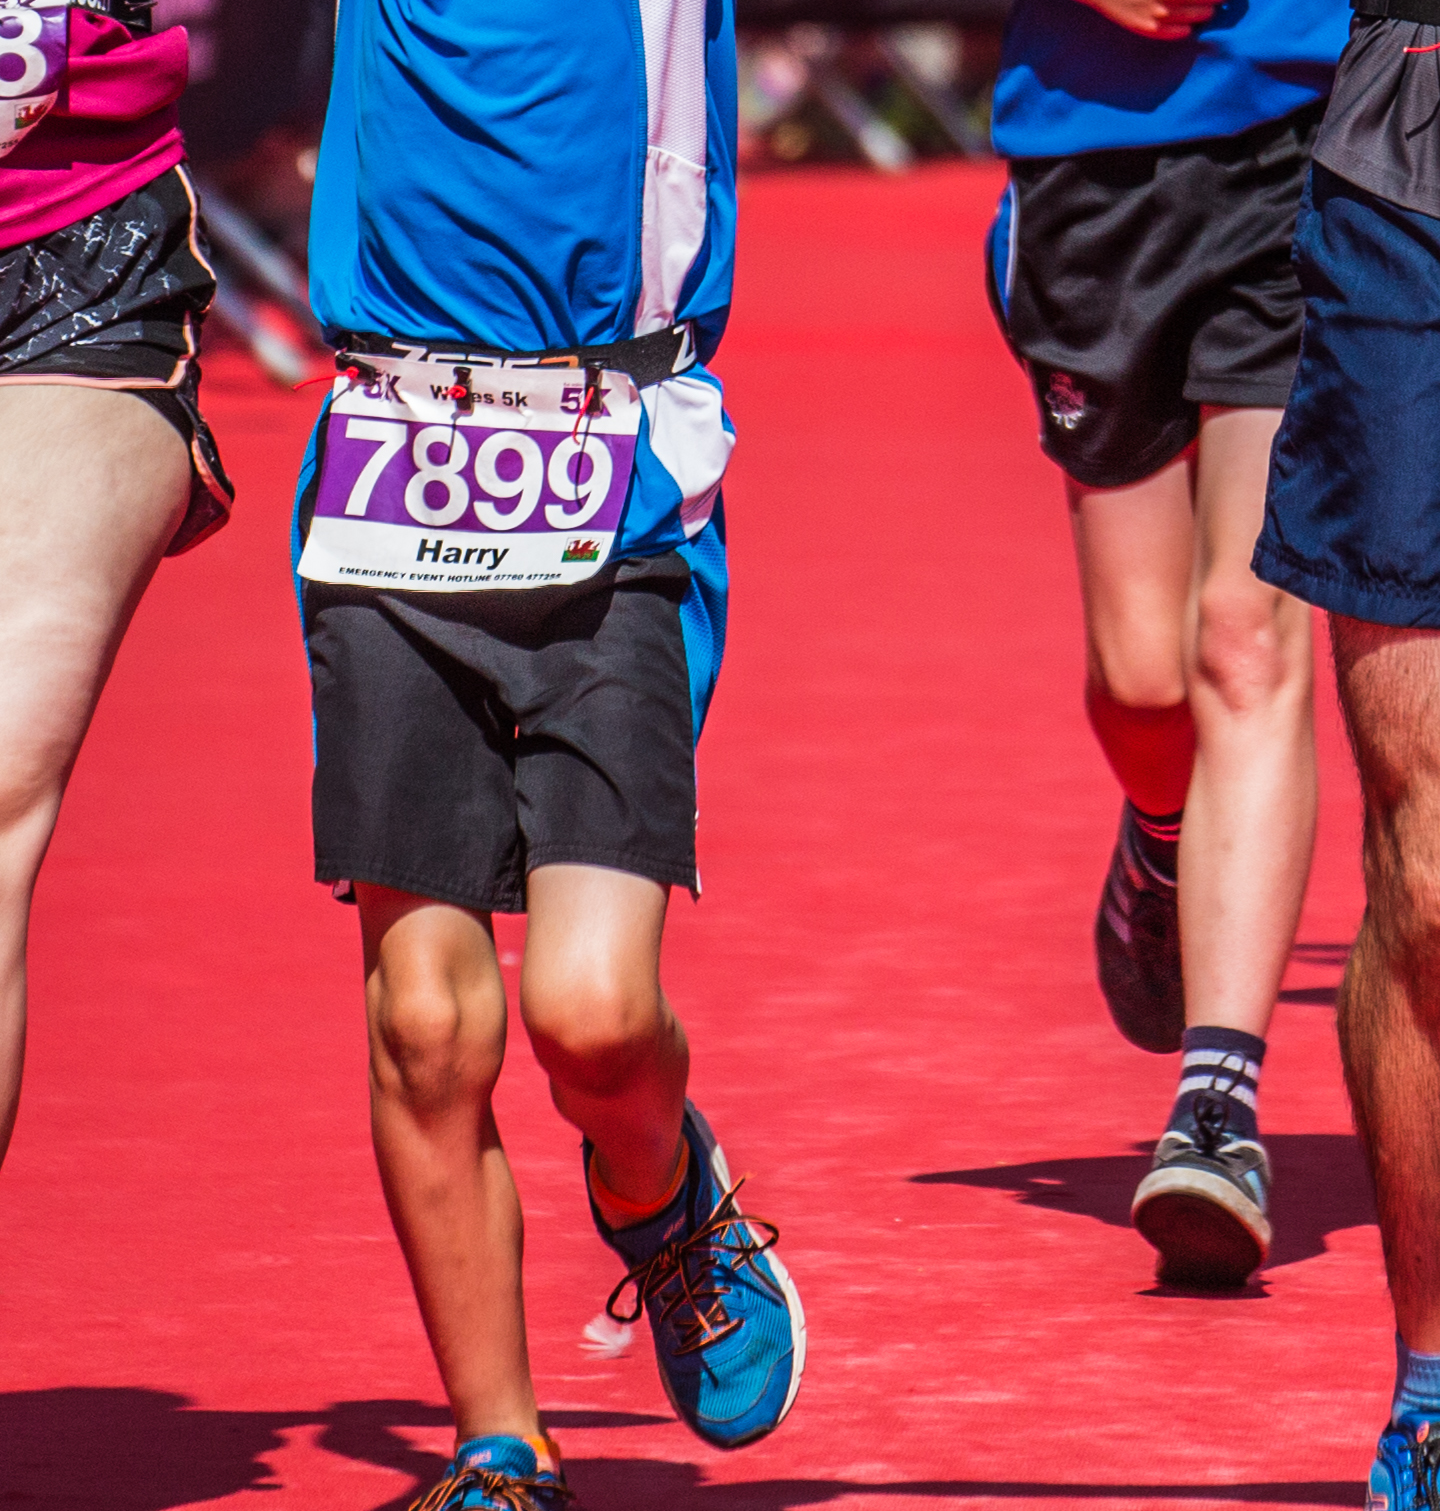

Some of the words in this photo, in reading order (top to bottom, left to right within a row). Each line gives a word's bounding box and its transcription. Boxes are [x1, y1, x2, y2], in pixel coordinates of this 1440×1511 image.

[501, 391, 528, 408] 5k
[343, 417, 614, 531] 7899
[415, 538, 511, 570] Harry
[338, 566, 407, 580] EMERGENCY
[409, 572, 445, 582] EVENT
[446, 574, 491, 583] HOTLINE
